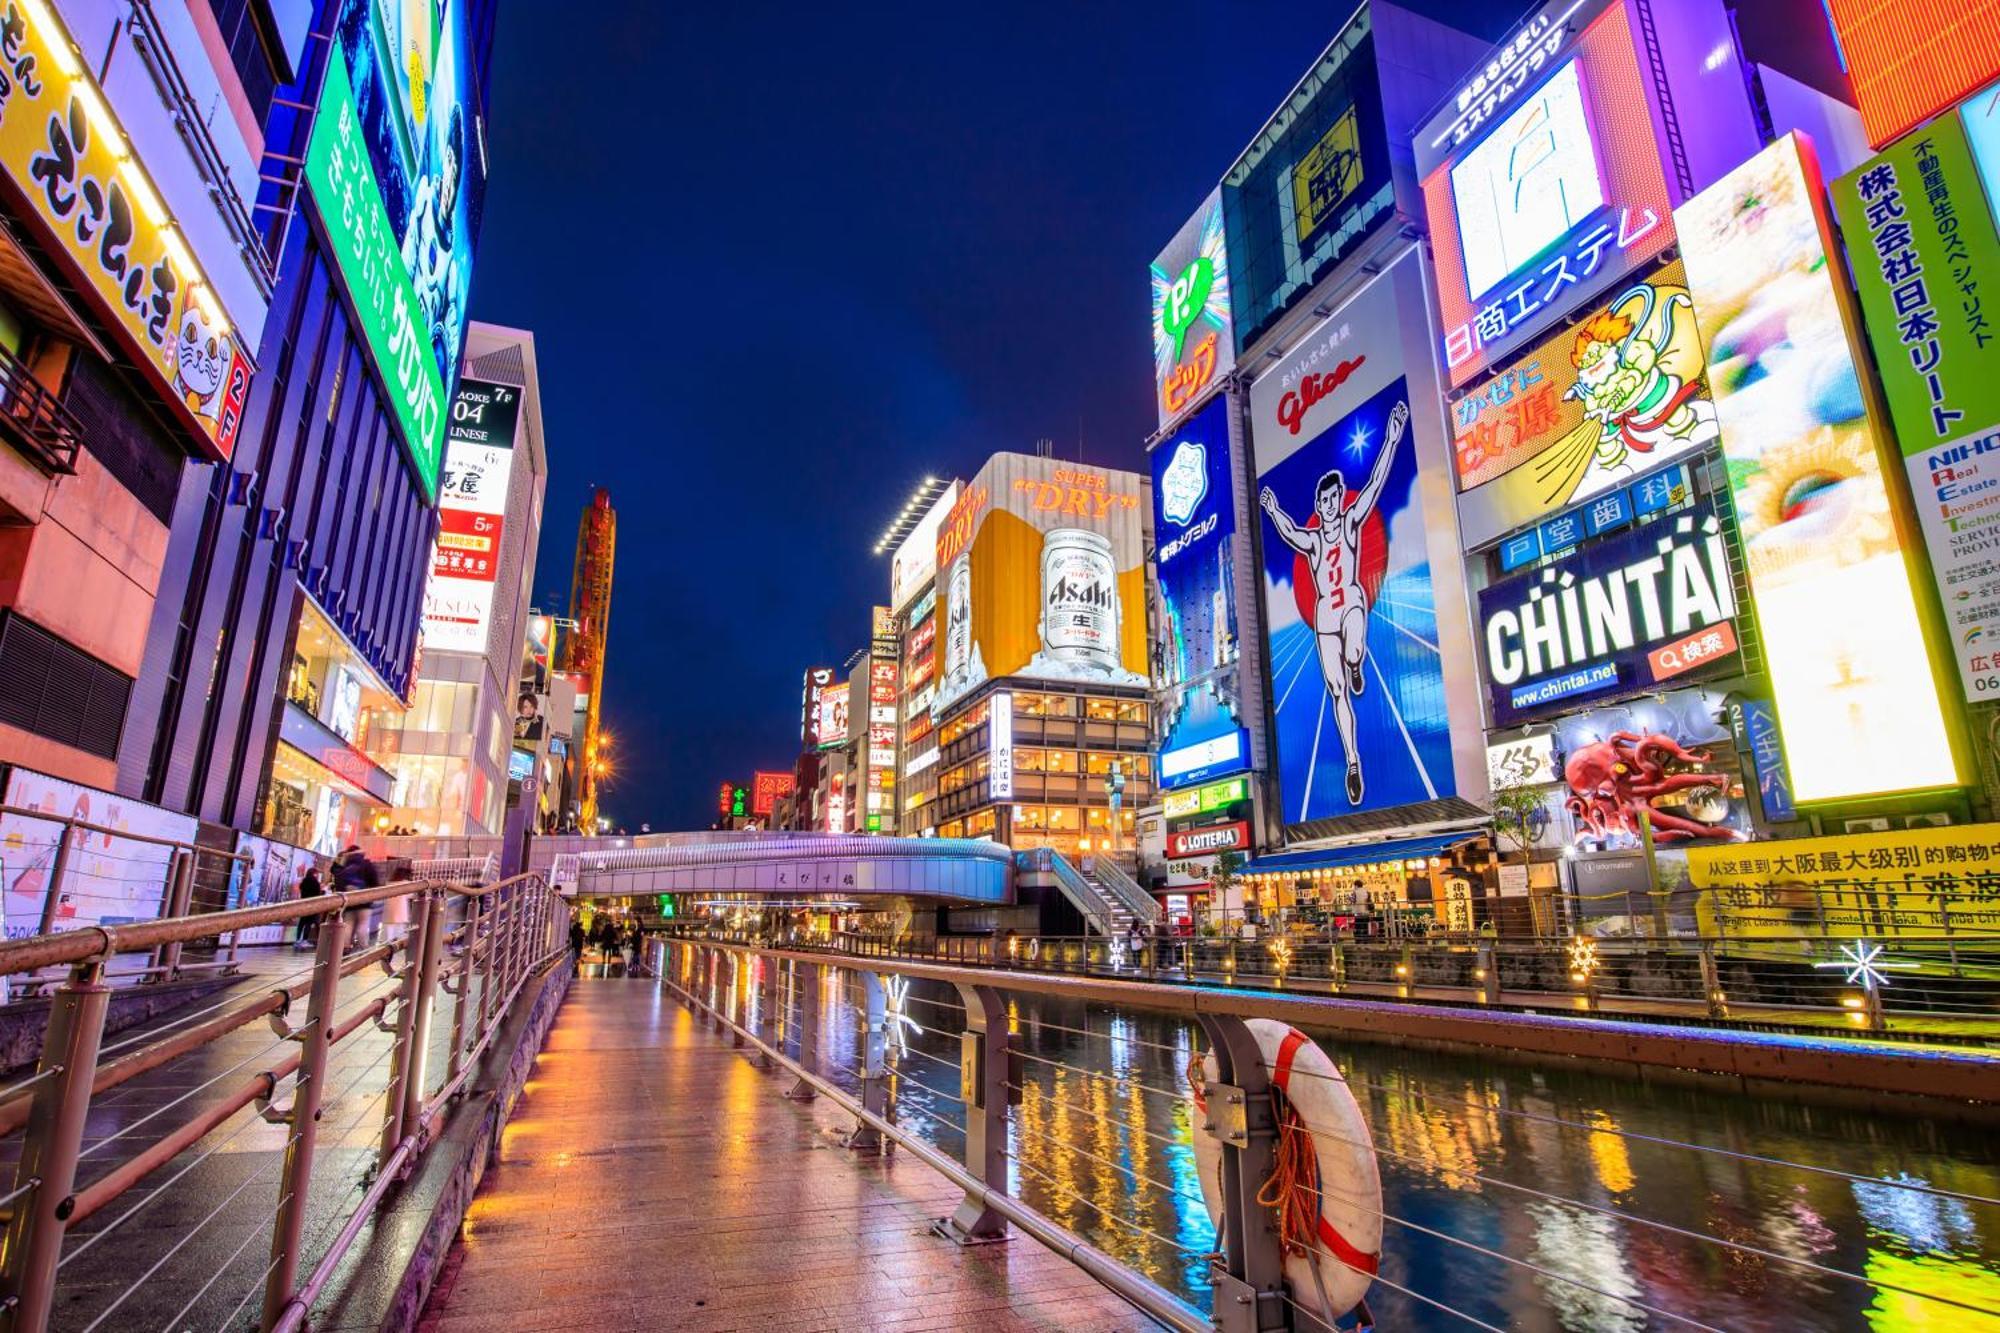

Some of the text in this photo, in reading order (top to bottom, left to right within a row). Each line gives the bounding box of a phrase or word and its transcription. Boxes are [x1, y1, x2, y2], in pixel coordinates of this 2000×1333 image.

[328, 144, 387, 331] きもちいい。
[1912, 137, 1993, 349] 不動産再生のスペシャリスト
[1444, 206, 1661, 368] 日商エステム
[1857, 163, 1963, 436] 株式会社日本リート
[1162, 331, 1219, 413] ピップ
[220, 368, 246, 441] 2F
[493, 387, 512, 403] 7F
[1277, 354, 1367, 436] Glico
[1456, 361, 1545, 427] かぜに
[1454, 380, 1561, 477] 改源
[1053, 469, 1107, 489] SUPER
[1932, 464, 1979, 487] Real
[1936, 478, 1998, 503] Estate
[474, 516, 494, 532] 5F
[1049, 575, 1112, 610] Asahi
[1326, 541, 1345, 610] グリコ
[1487, 516, 1740, 686] CHINTAI
[1072, 613, 1092, 628] 生
[1681, 630, 1725, 663] 検索
[1731, 703, 1745, 738] 2F
[1500, 745, 1542, 779] くくる
[1187, 829, 1235, 850] LOTTERIA
[1882, 912, 1922, 925] Oaka.
